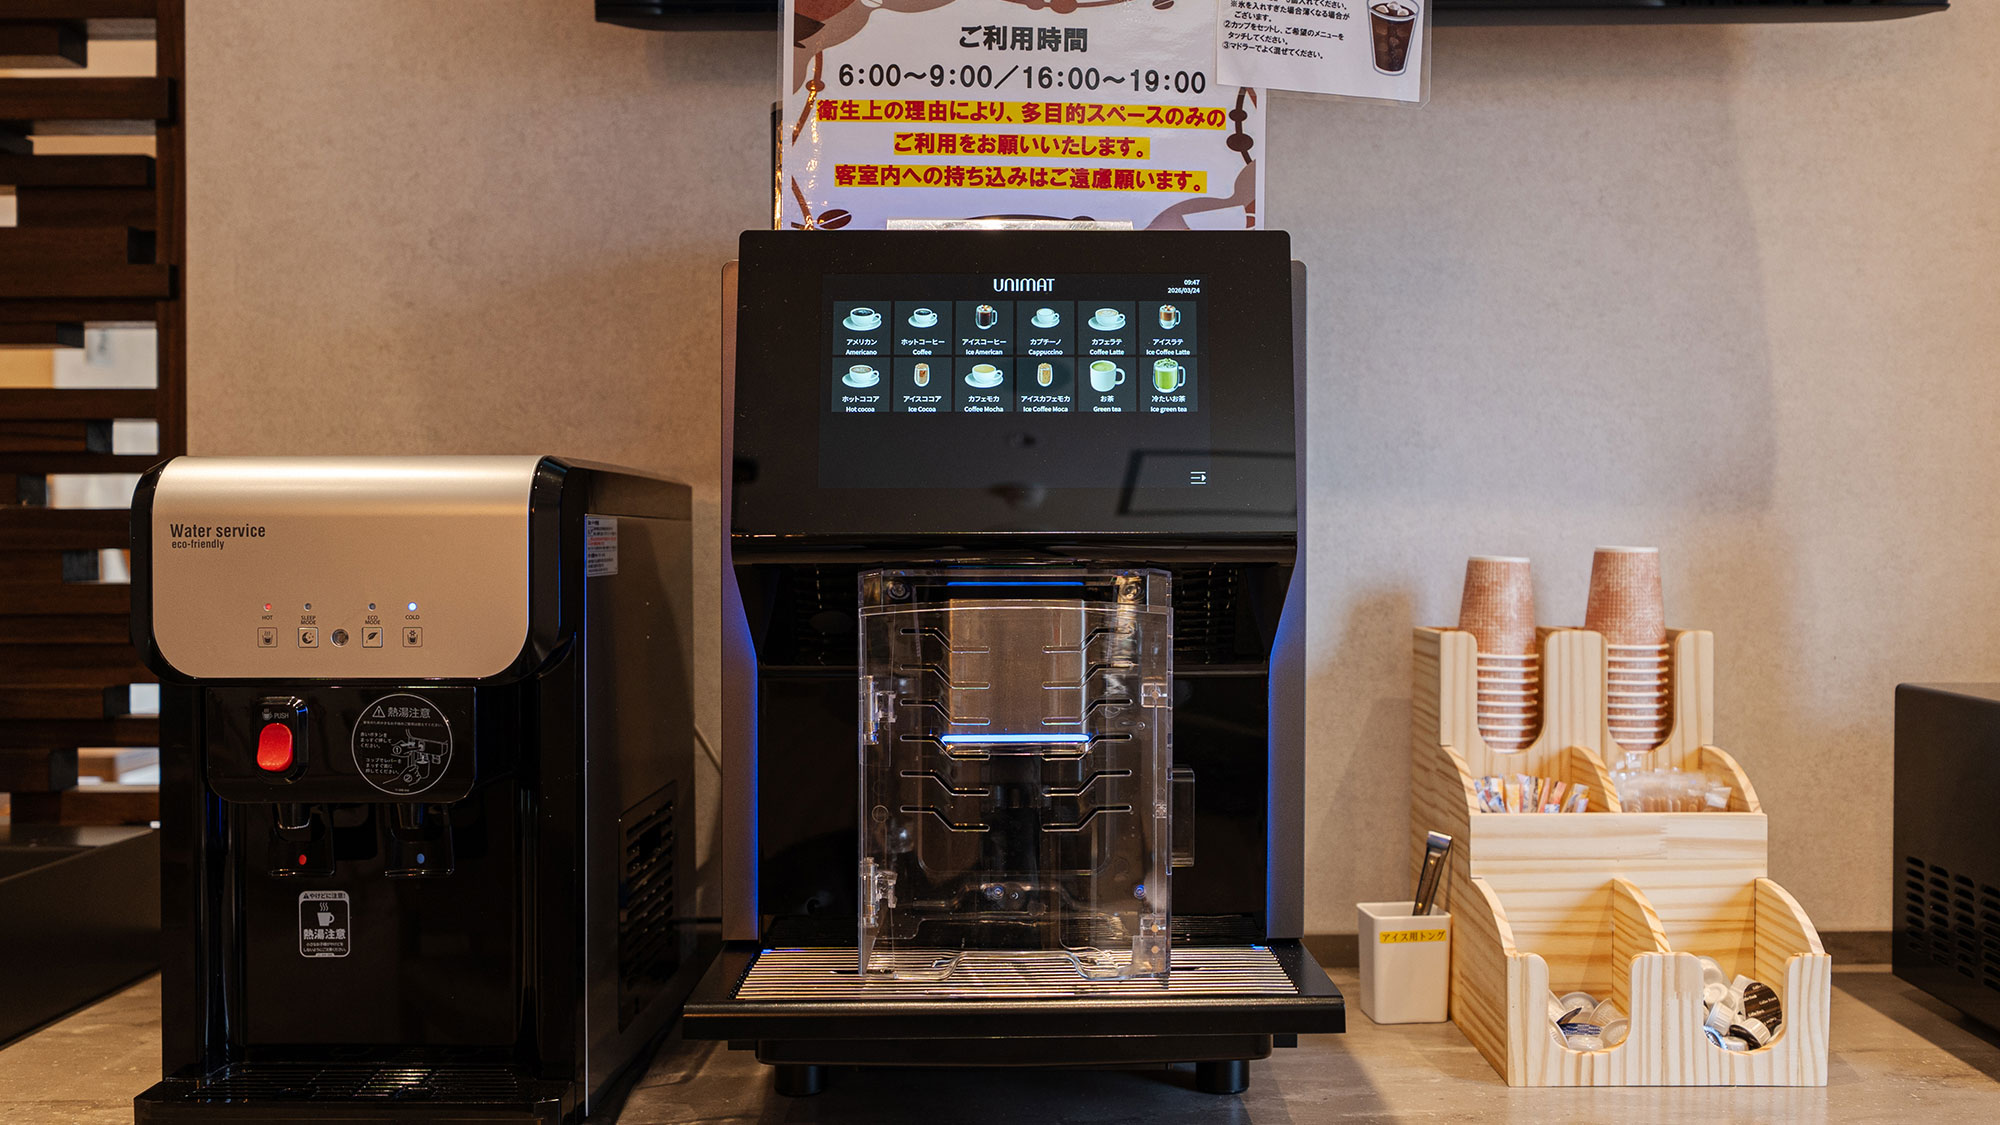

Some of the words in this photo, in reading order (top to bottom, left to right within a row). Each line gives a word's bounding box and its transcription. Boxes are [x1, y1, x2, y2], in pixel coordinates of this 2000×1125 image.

[1234, 11, 1272, 22] ございます。
[959, 24, 1088, 53] ご利用時間
[1228, 31, 1288, 45] タッチしてください。
[817, 100, 1226, 128] 衛生上の理由により、多目的スペースのみの
[894, 133, 1144, 158] ご利用をお願いいたします。
[835, 164, 1201, 191] 客室内への持ち込みはご遠慮願います。
[993, 278, 1055, 292] UNIMAT
[846, 338, 878, 346] アメリカン
[900, 338, 945, 346] ホットコーヒー
[961, 338, 1007, 346] アイスコーヒー
[1091, 338, 1122, 346] カフェラテ
[1152, 338, 1184, 346] アイスラテ
[841, 395, 880, 403] ホットココア
[903, 395, 942, 403] アイスココア
[968, 395, 999, 403] カフェモカ
[1021, 395, 1070, 403] アイスカフェモカ
[1100, 395, 1114, 403] お茶
[1151, 395, 1186, 403] 冷たいお茶
[1160, 406, 1177, 414] green
[170, 523, 212, 538] Water
[216, 523, 266, 538] service
[171, 539, 225, 550] eco-friendly
[387, 707, 431, 719] 熱湯注意
[303, 928, 346, 940] 熱湯注意
[1382, 930, 1446, 942] アイス用トング
